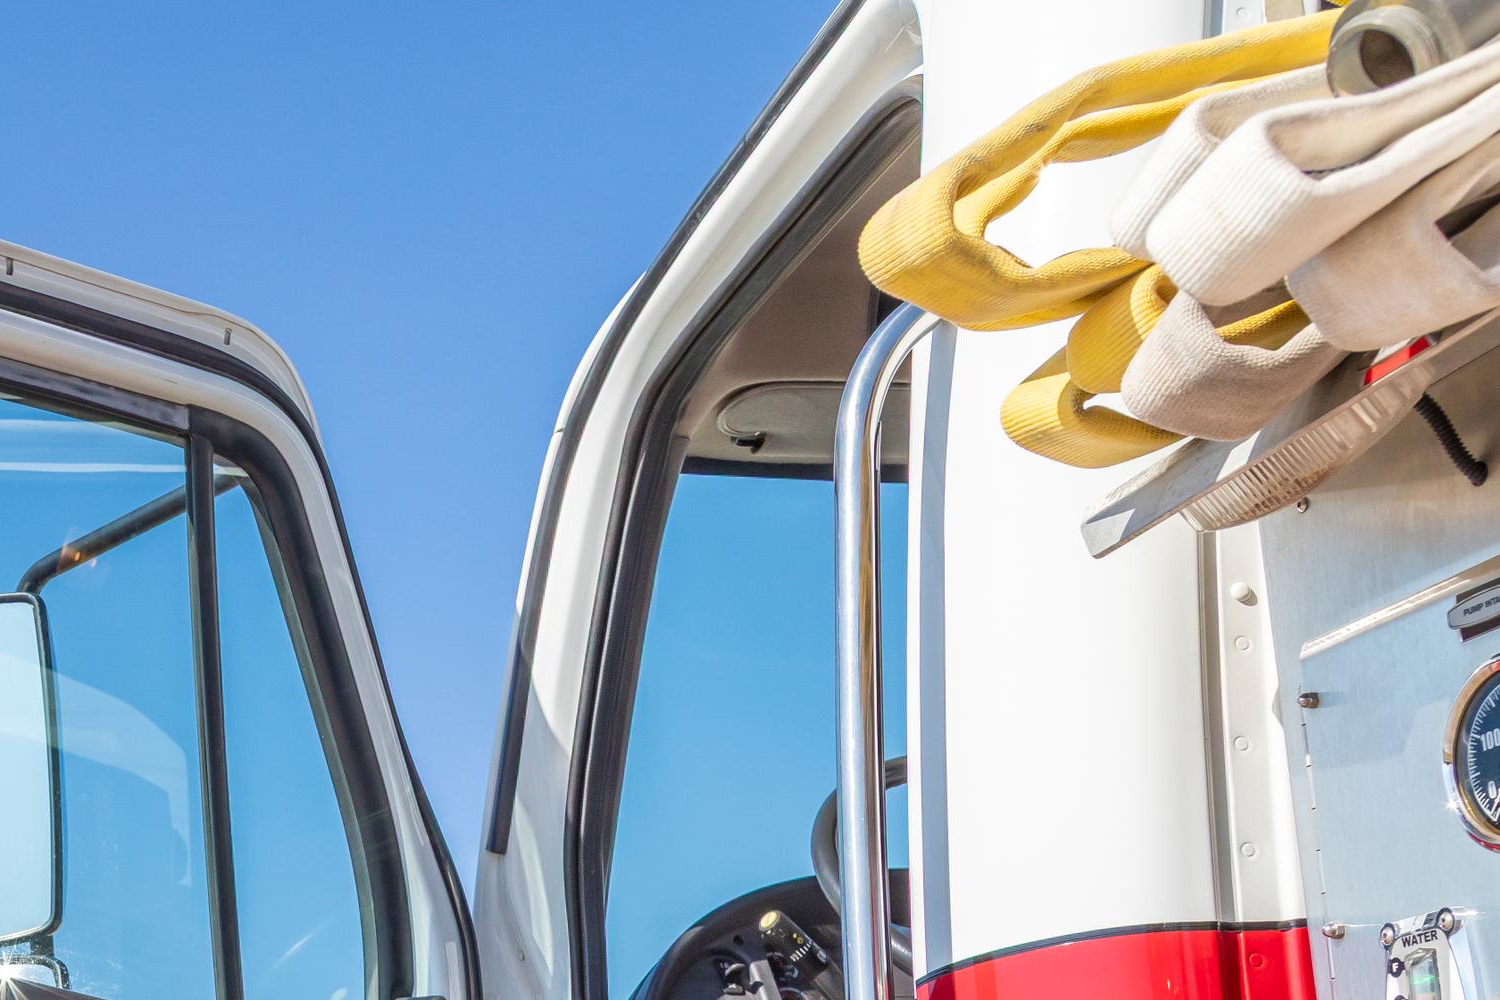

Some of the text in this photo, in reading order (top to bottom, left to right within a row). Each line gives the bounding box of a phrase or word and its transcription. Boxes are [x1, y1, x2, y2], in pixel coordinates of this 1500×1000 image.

[1462, 602, 1484, 616] PUMP
[1400, 930, 1438, 948] WATER
[1392, 963, 1398, 973] F
